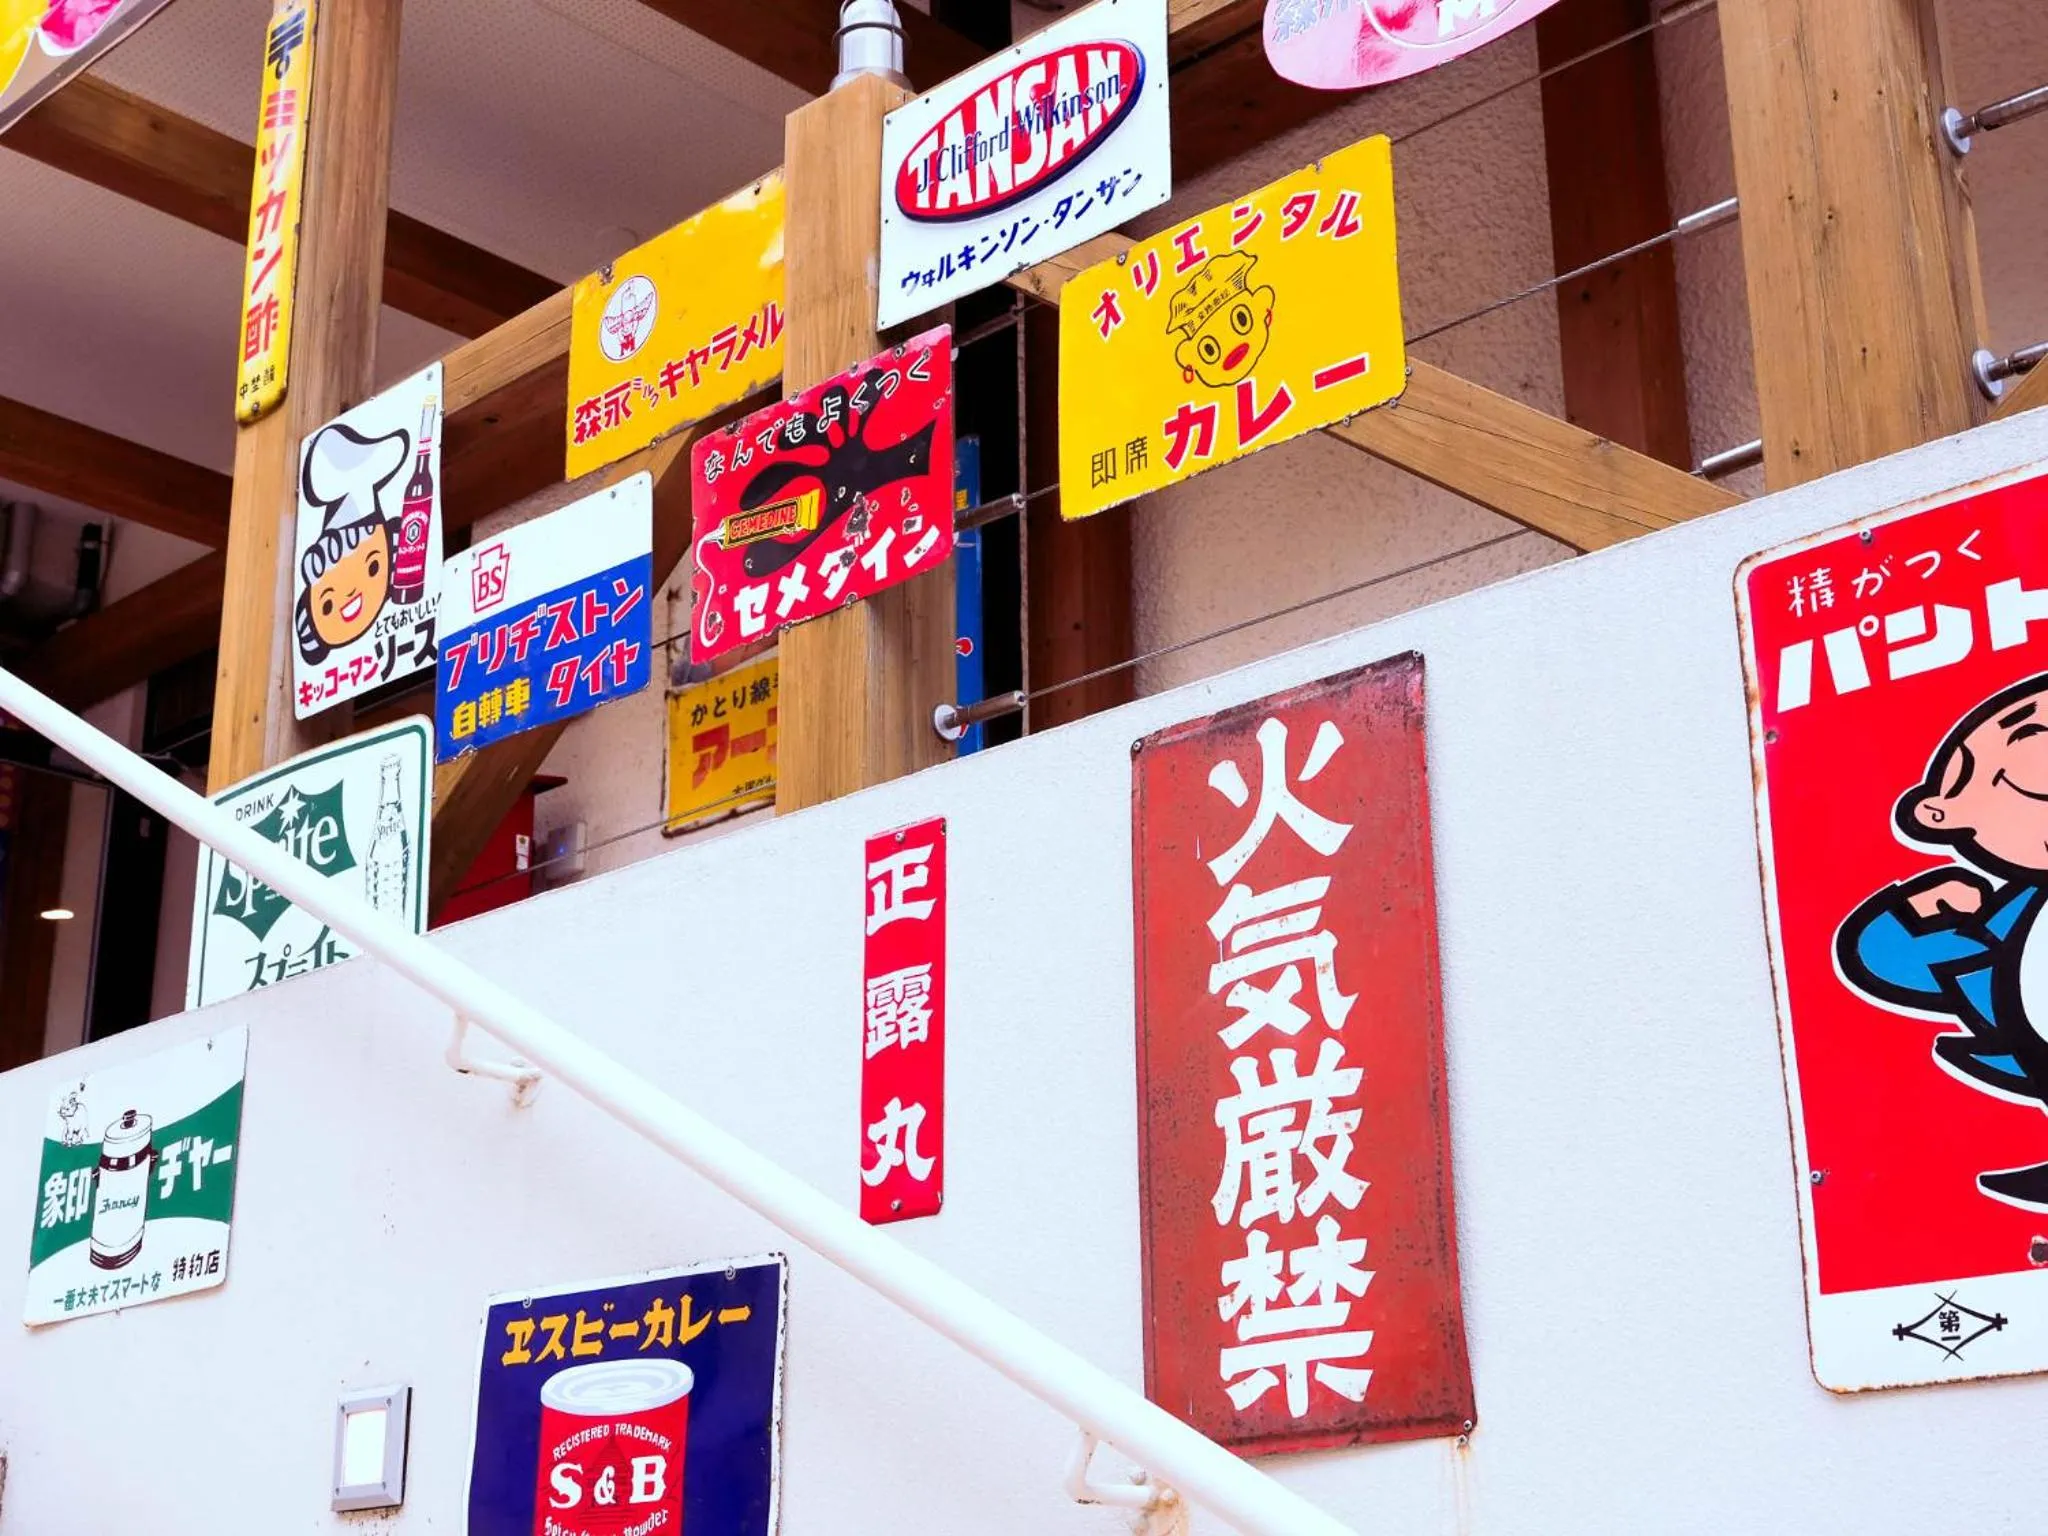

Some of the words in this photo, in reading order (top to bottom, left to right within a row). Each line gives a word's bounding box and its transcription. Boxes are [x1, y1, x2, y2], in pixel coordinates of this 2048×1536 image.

[907, 50, 1121, 208] TANSAN
[1092, 189, 1362, 341] オリエンタル
[704, 349, 931, 484] なんでもよくつく
[1091, 436, 1148, 488] 即席
[1164, 353, 1369, 471] カレー
[730, 504, 797, 540] CEMEDINE
[1786, 529, 1982, 618] 精がつく
[477, 565, 502, 603] BS
[733, 514, 940, 638] セメダイン
[546, 638, 641, 708] タイヤ
[235, 792, 275, 821] DRINK
[860, 842, 937, 1188] 正露丸
[1206, 716, 1377, 1420] 火気厳禁
[40, 1165, 93, 1229] 象印
